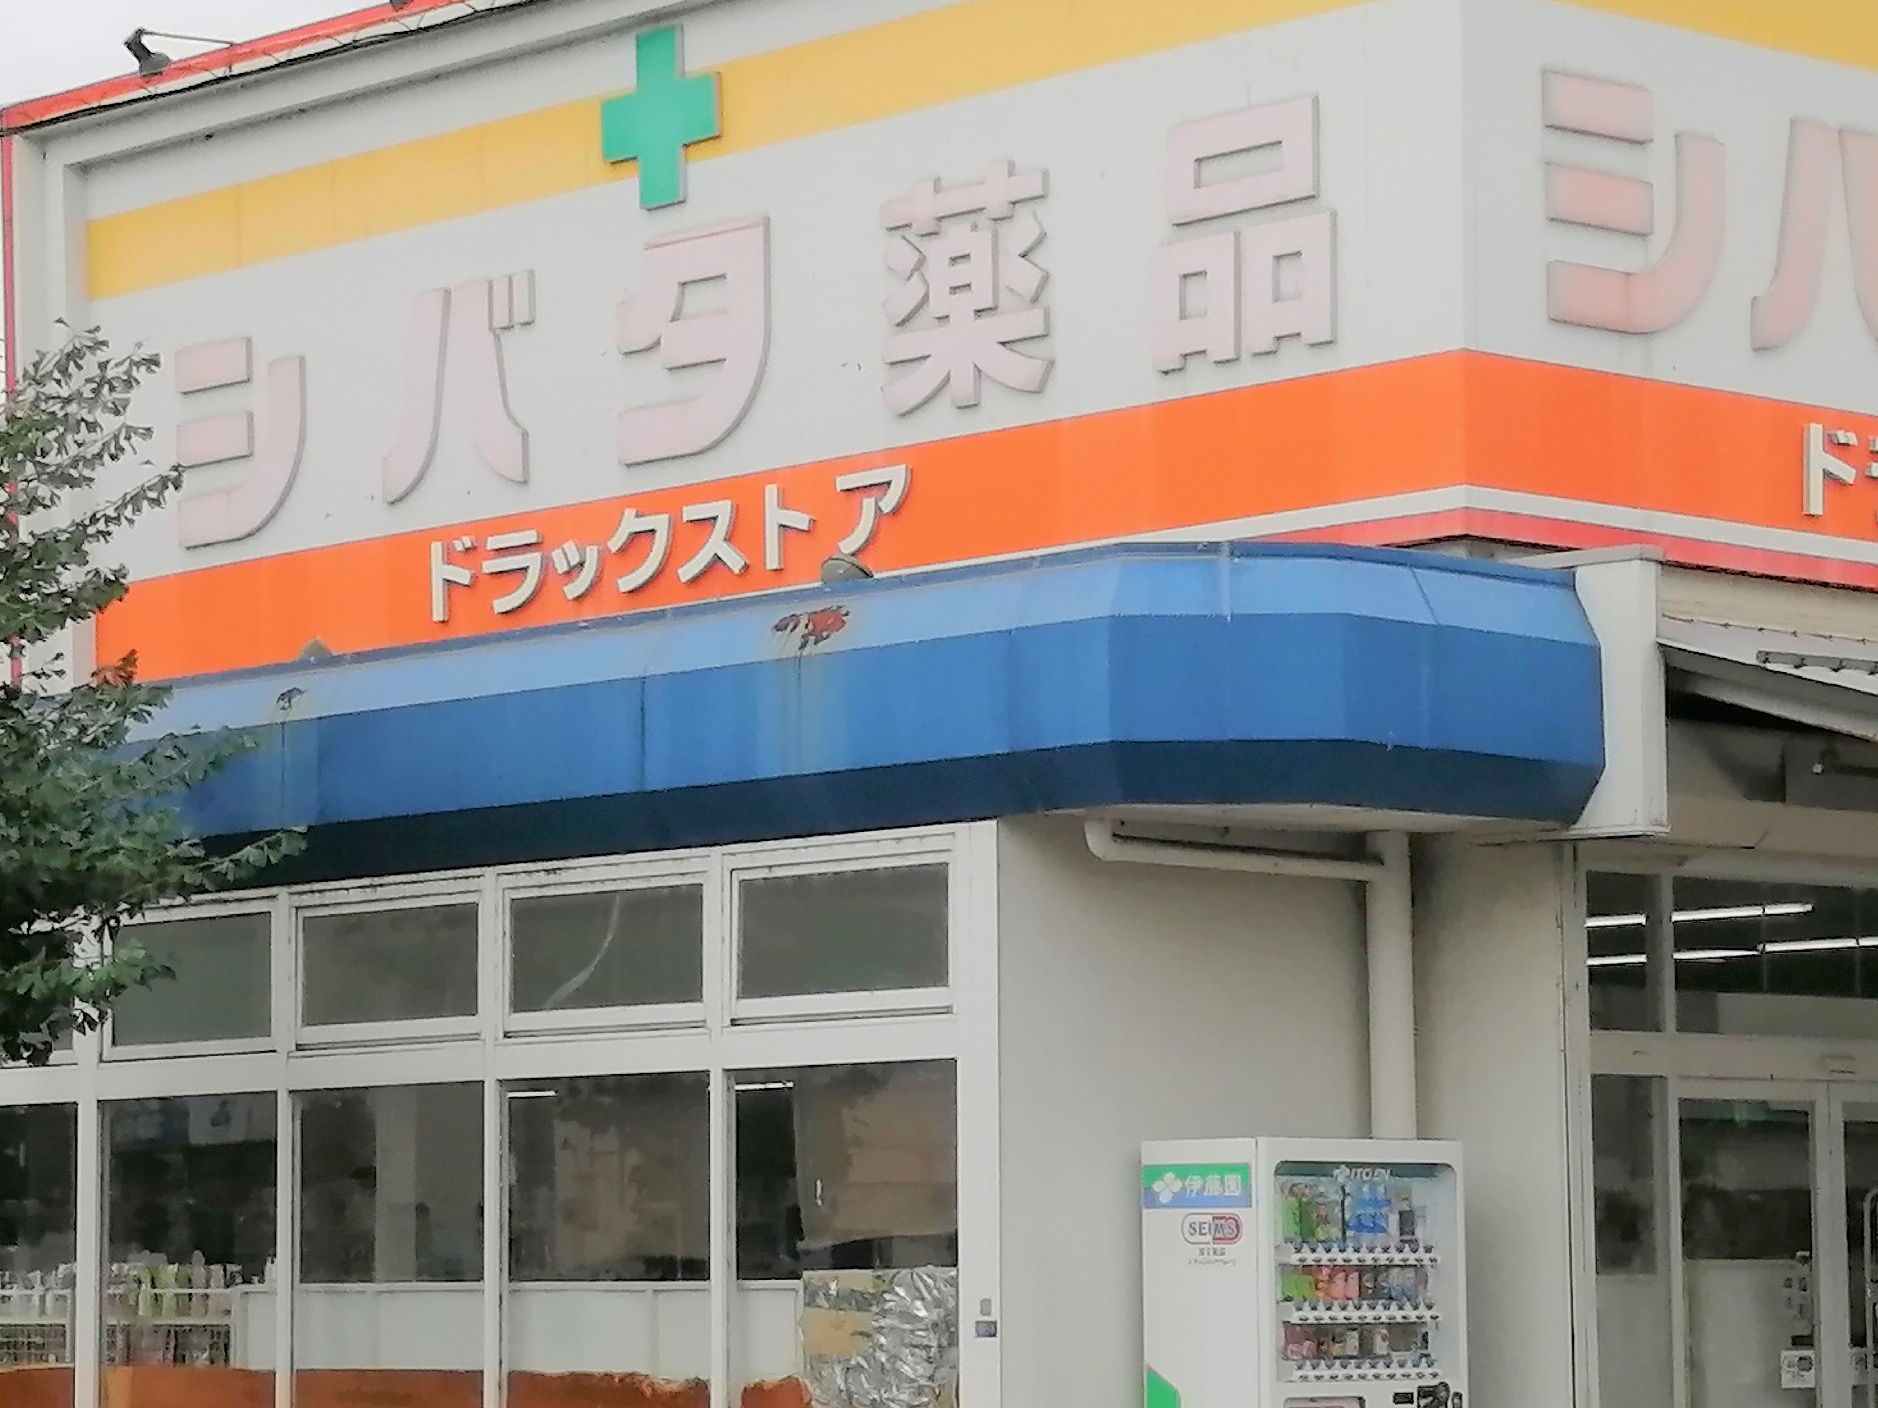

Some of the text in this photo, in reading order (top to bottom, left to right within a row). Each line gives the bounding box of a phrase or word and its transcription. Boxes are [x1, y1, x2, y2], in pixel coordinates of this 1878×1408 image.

[175, 93, 1339, 550] シバタ薬品
[429, 464, 912, 623] ドラックストア
[1187, 1221, 1236, 1237] SEIMS
